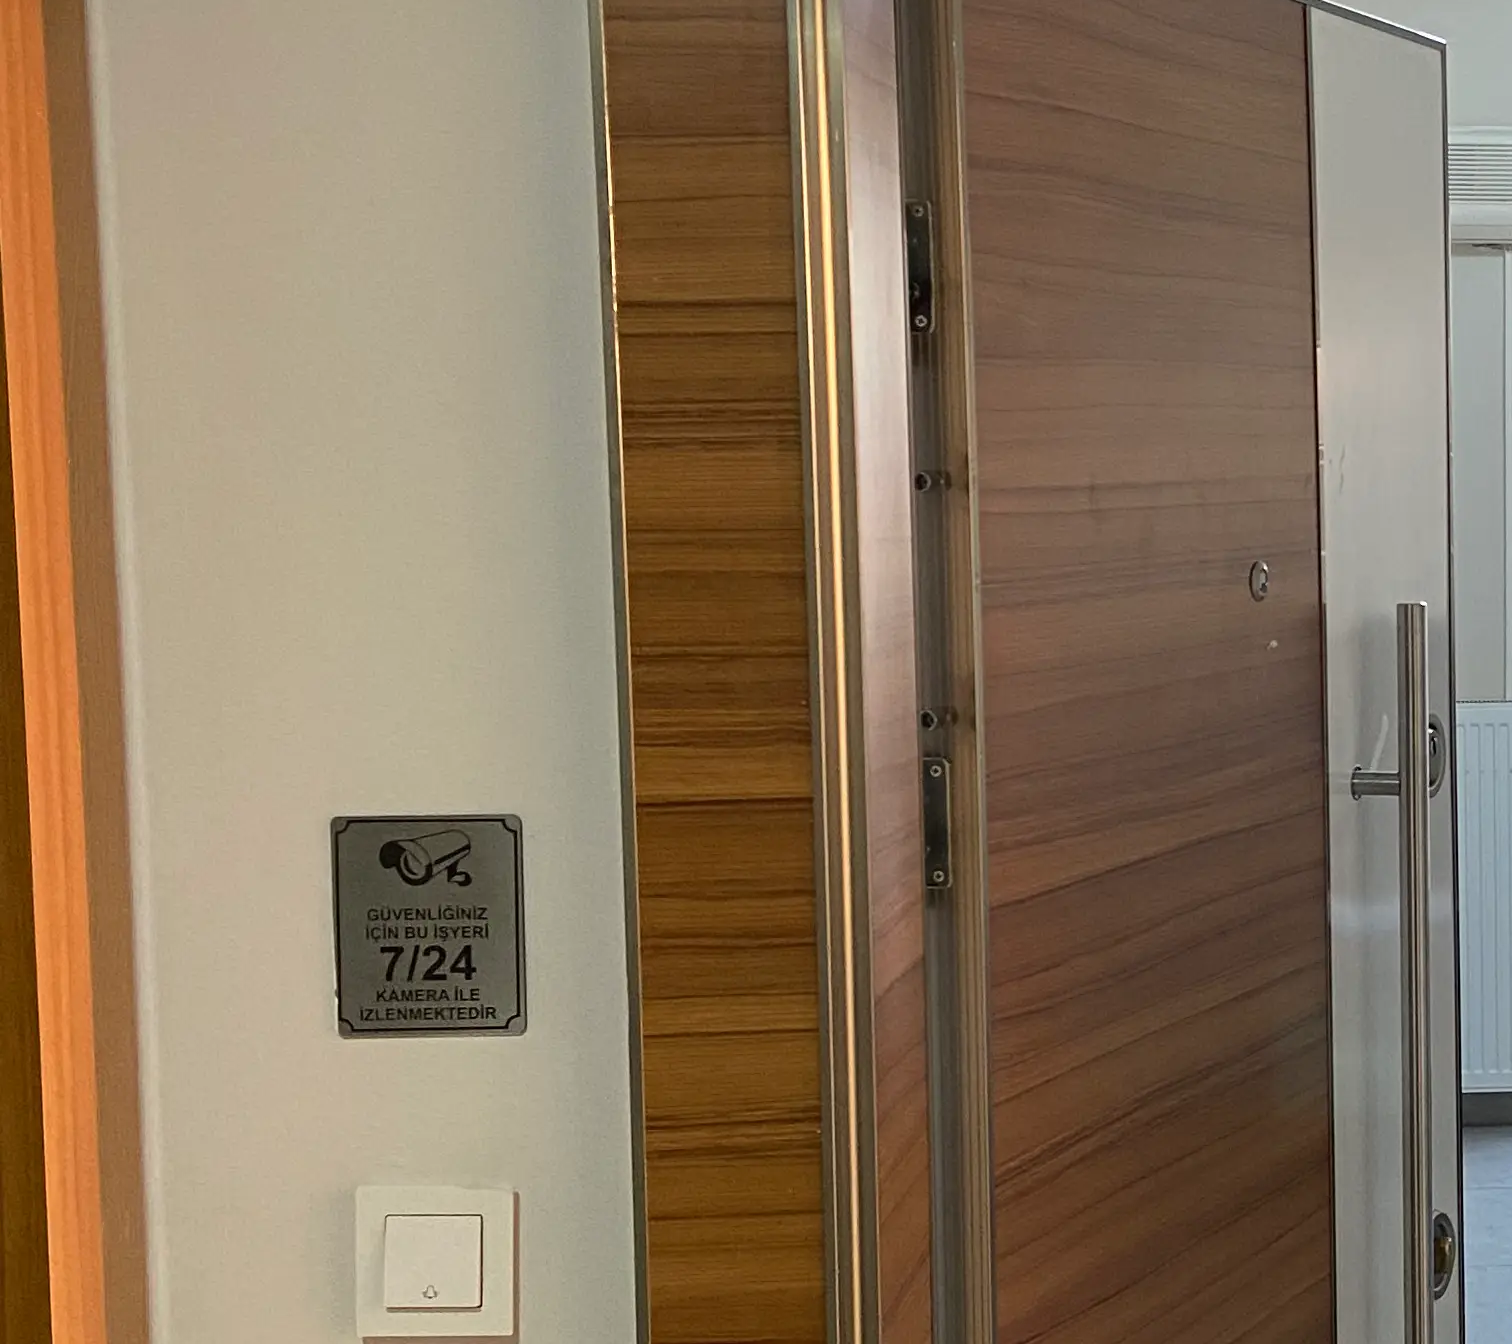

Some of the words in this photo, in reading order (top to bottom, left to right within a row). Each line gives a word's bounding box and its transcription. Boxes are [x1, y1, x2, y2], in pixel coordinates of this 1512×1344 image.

[367, 905, 488, 921] GÜVENLİĞİNİZ
[365, 925, 399, 941] İÇİN
[404, 926, 428, 939] BU
[433, 923, 489, 942] İŞYERİ
[380, 944, 477, 982] 7/24
[376, 988, 450, 1002] KAMERA
[455, 985, 480, 1001] İLE
[360, 1004, 497, 1021] İZLENMEKTEDİR
